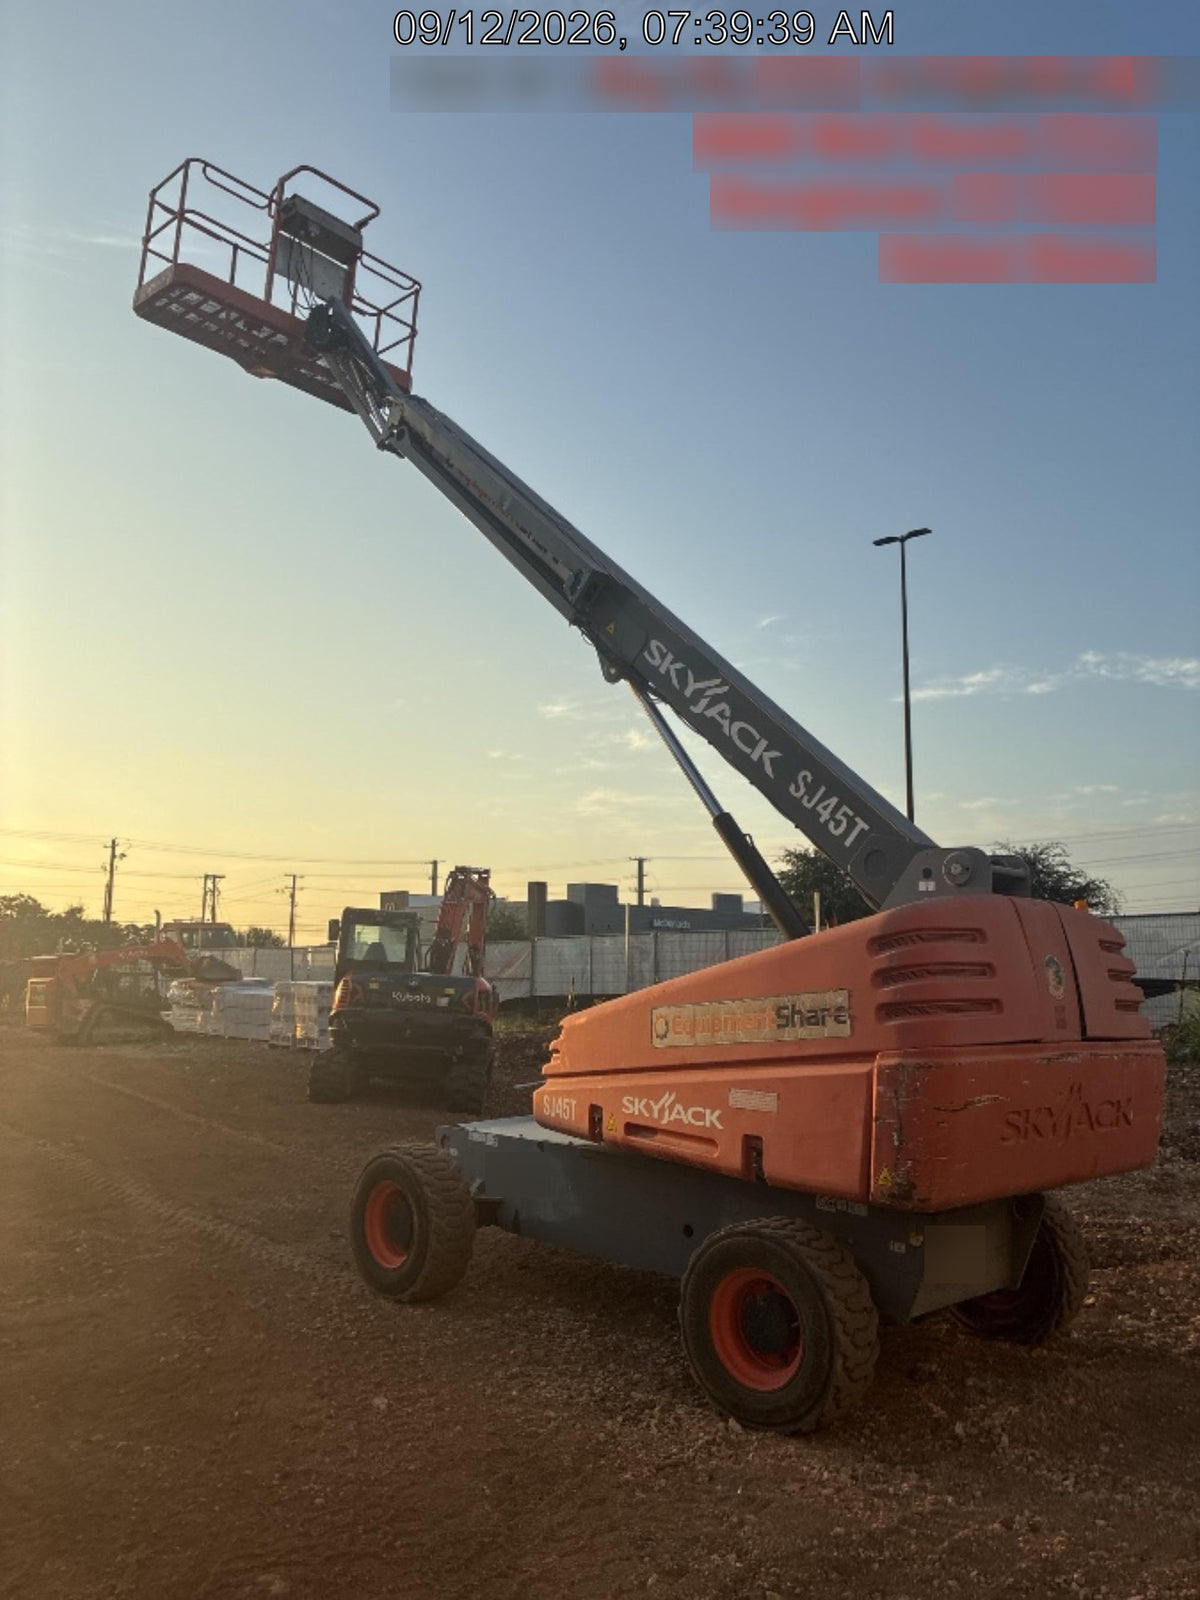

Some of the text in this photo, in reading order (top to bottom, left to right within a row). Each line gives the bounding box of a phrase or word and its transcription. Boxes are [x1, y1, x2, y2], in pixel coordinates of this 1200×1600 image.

[644, 639, 870, 848] SKYJACK SJ45T
[392, 991, 431, 1003] Kubota
[543, 1095, 577, 1121] SJ45T
[622, 1091, 724, 1130] SKYJACK
[1000, 1082, 1133, 1142] SKYJACK
